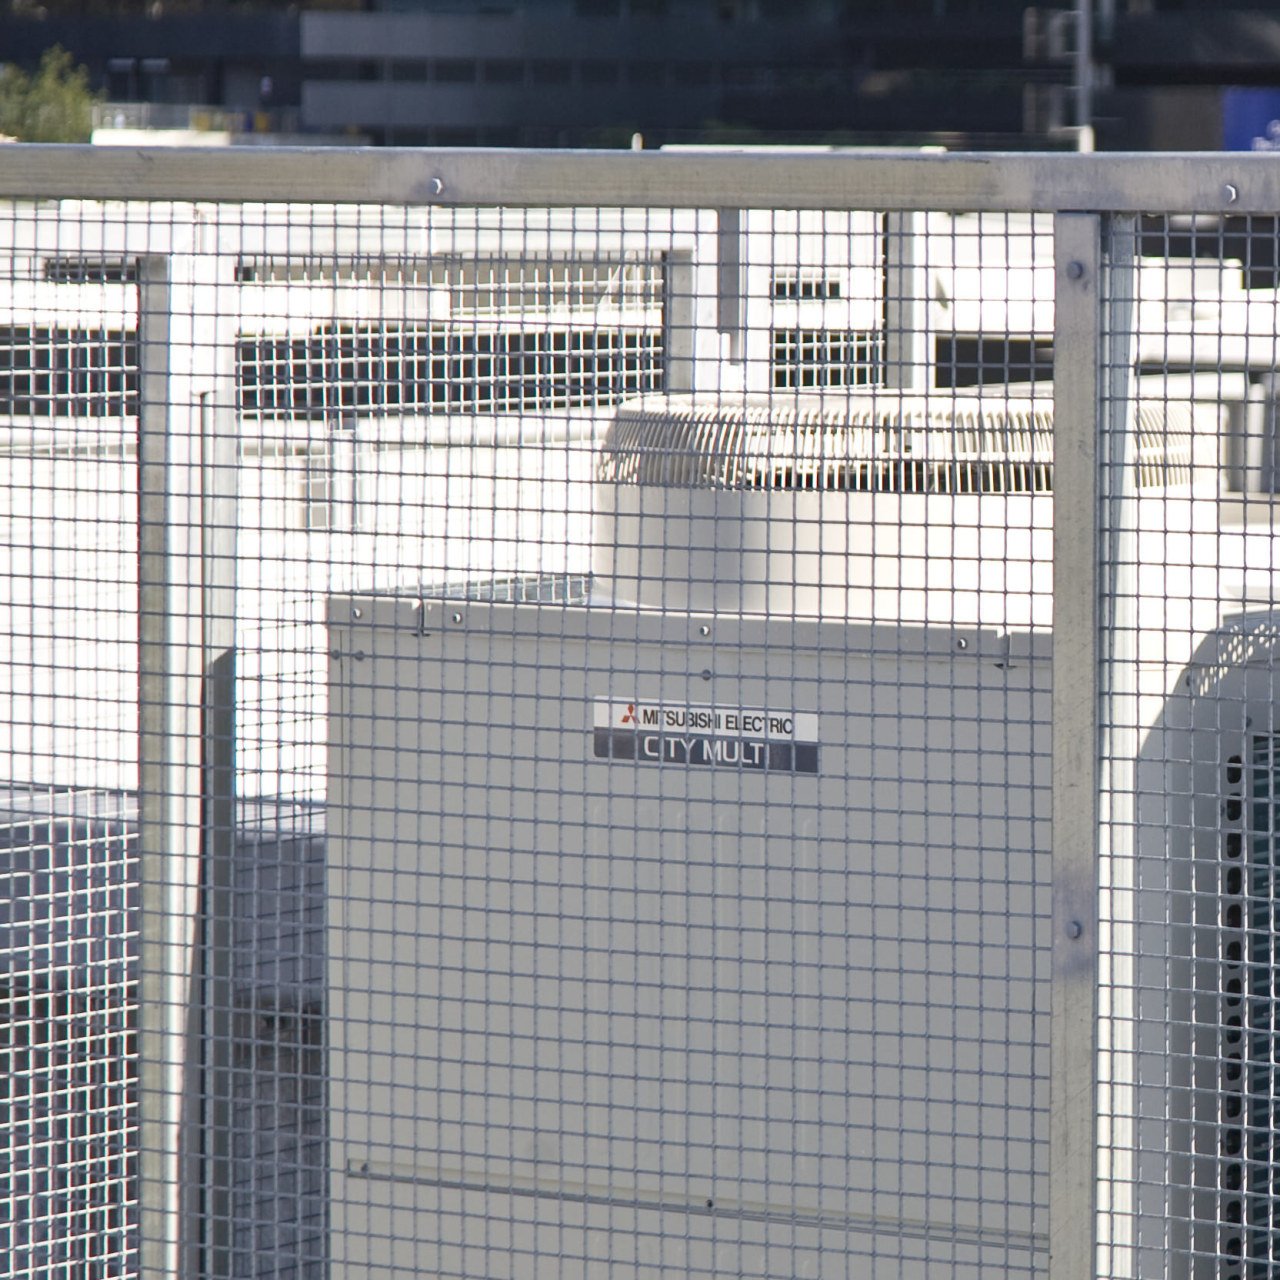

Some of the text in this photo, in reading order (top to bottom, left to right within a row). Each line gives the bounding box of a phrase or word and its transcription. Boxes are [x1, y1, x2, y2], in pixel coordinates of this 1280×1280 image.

[643, 709, 793, 734] MISUBISHI ELECRIC
[643, 735, 697, 759] CTY
